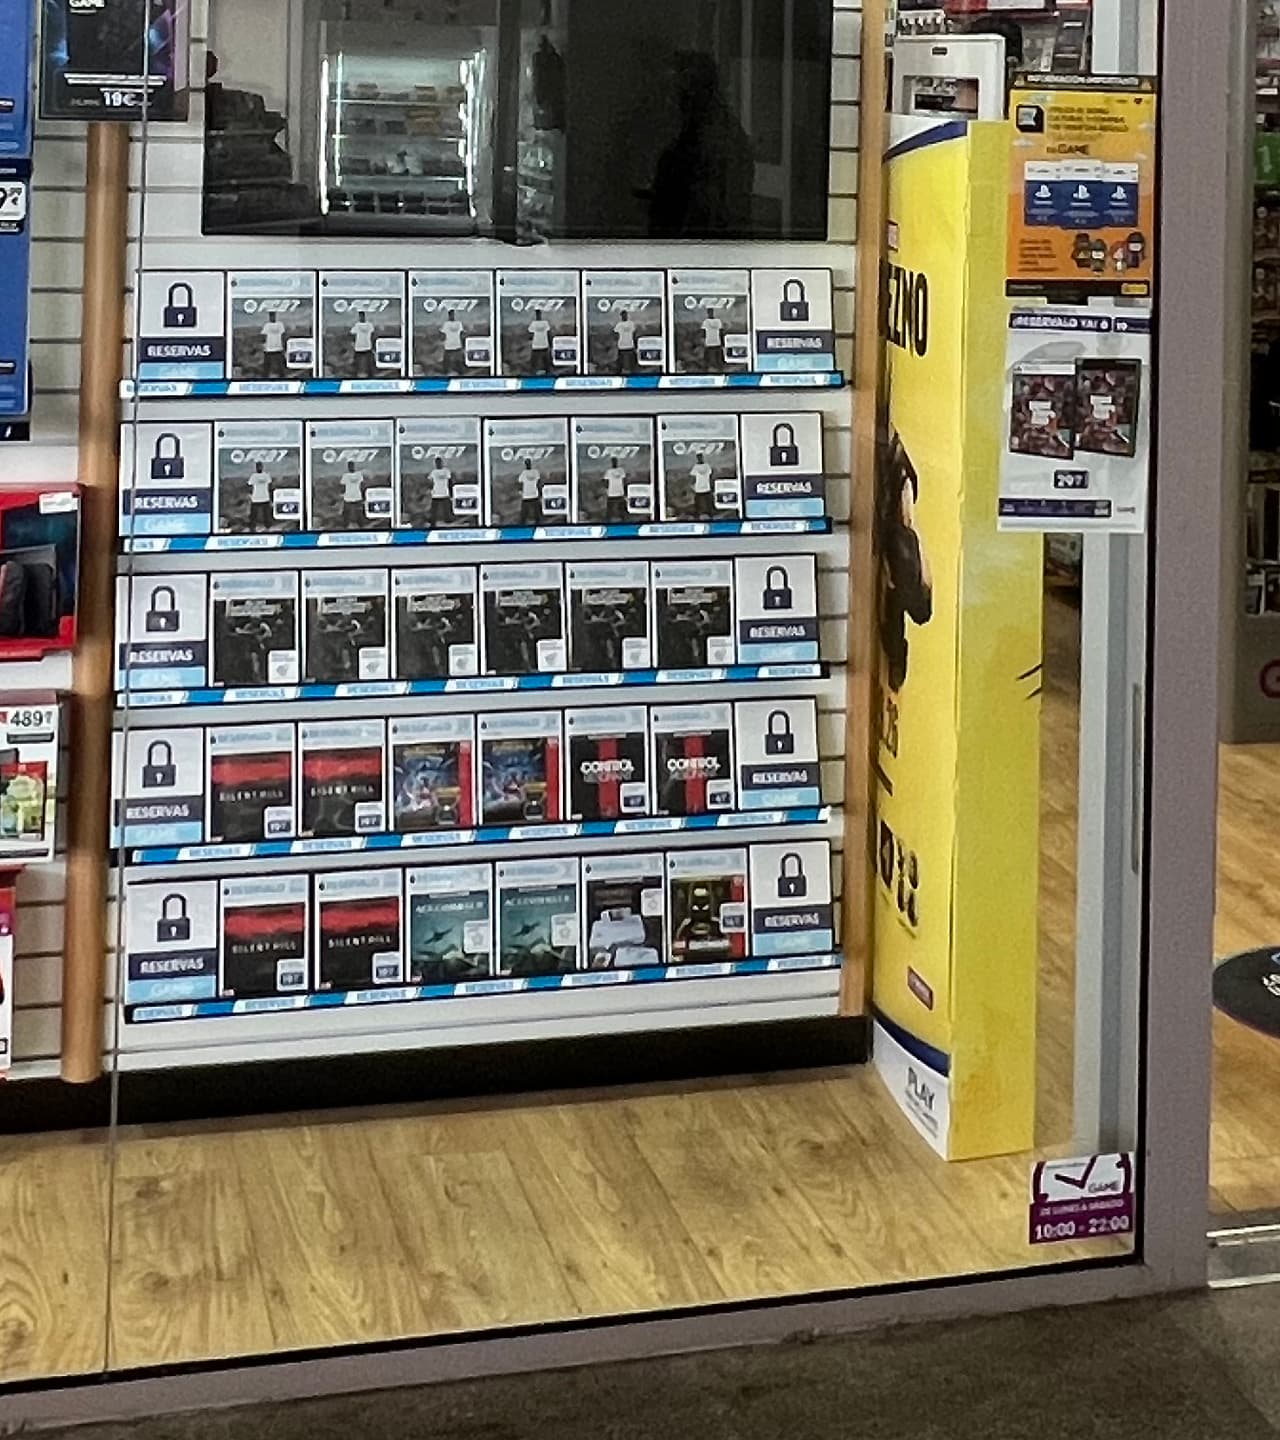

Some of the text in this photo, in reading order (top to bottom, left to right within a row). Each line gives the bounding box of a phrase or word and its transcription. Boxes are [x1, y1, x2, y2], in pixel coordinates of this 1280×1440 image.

[886, 262, 928, 357] EZNO
[766, 336, 823, 350] RESERVAS
[147, 344, 212, 358] RESERVAS
[756, 480, 812, 494] RESERVAS
[134, 495, 198, 510] RESERVAS
[749, 625, 806, 639] RESERVAS
[129, 649, 194, 663] RESERVAS
[10, 709, 44, 729] 489
[751, 769, 808, 784] RESERVAS
[126, 804, 190, 819] RESERVAS
[764, 912, 819, 927] RESERVAS
[140, 957, 204, 973] RESERVAS
[906, 1065, 936, 1111] PLAY
[1035, 1221, 1076, 1240] 10:00
[1088, 1215, 1130, 1233] 22:00
